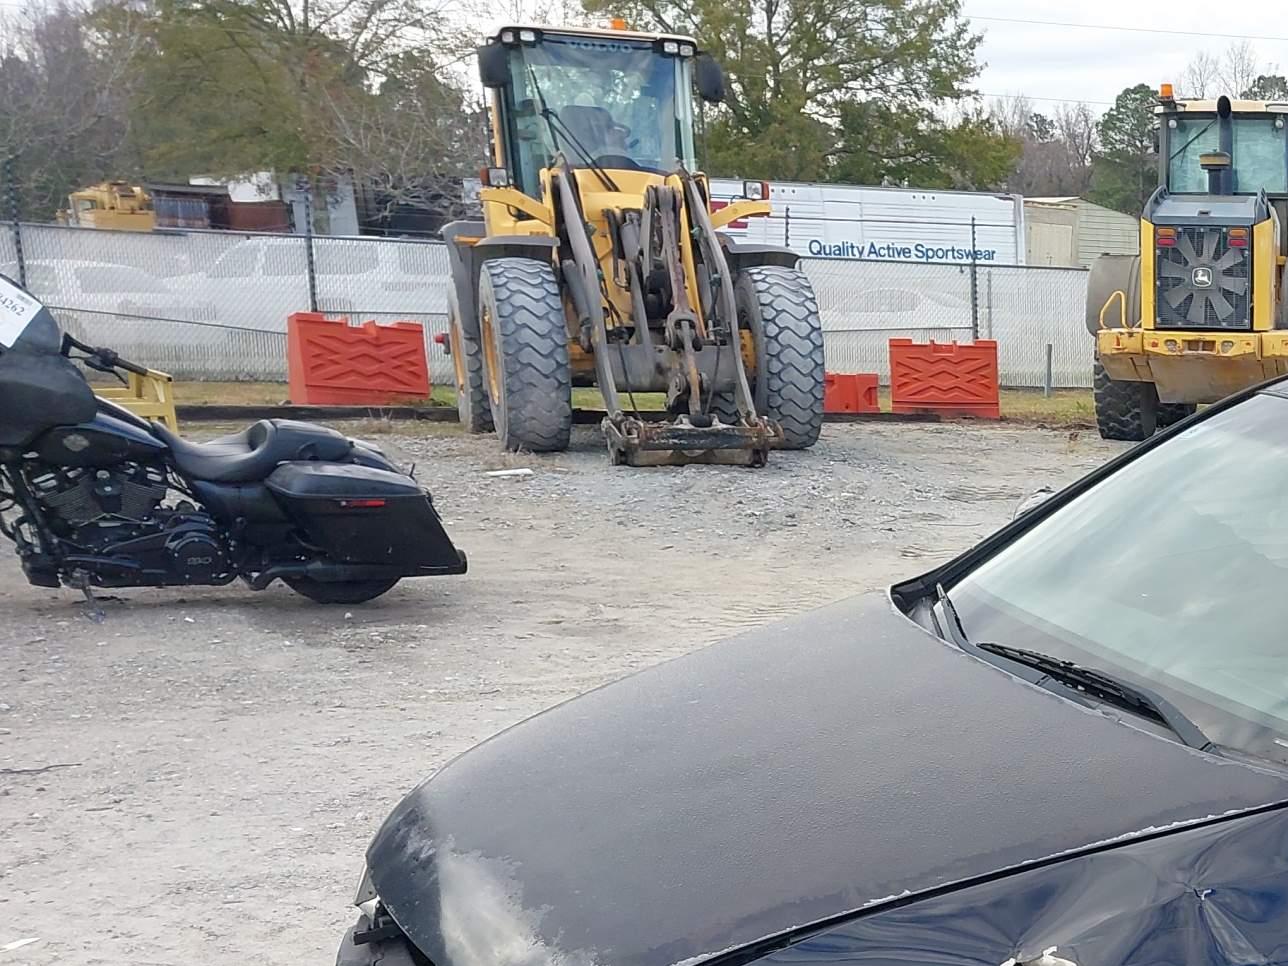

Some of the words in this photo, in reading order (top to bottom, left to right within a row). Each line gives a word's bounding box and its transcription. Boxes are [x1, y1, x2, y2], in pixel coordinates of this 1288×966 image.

[808, 239, 865, 258] Quality
[867, 241, 911, 259] Active
[914, 243, 996, 262] Sportswear
